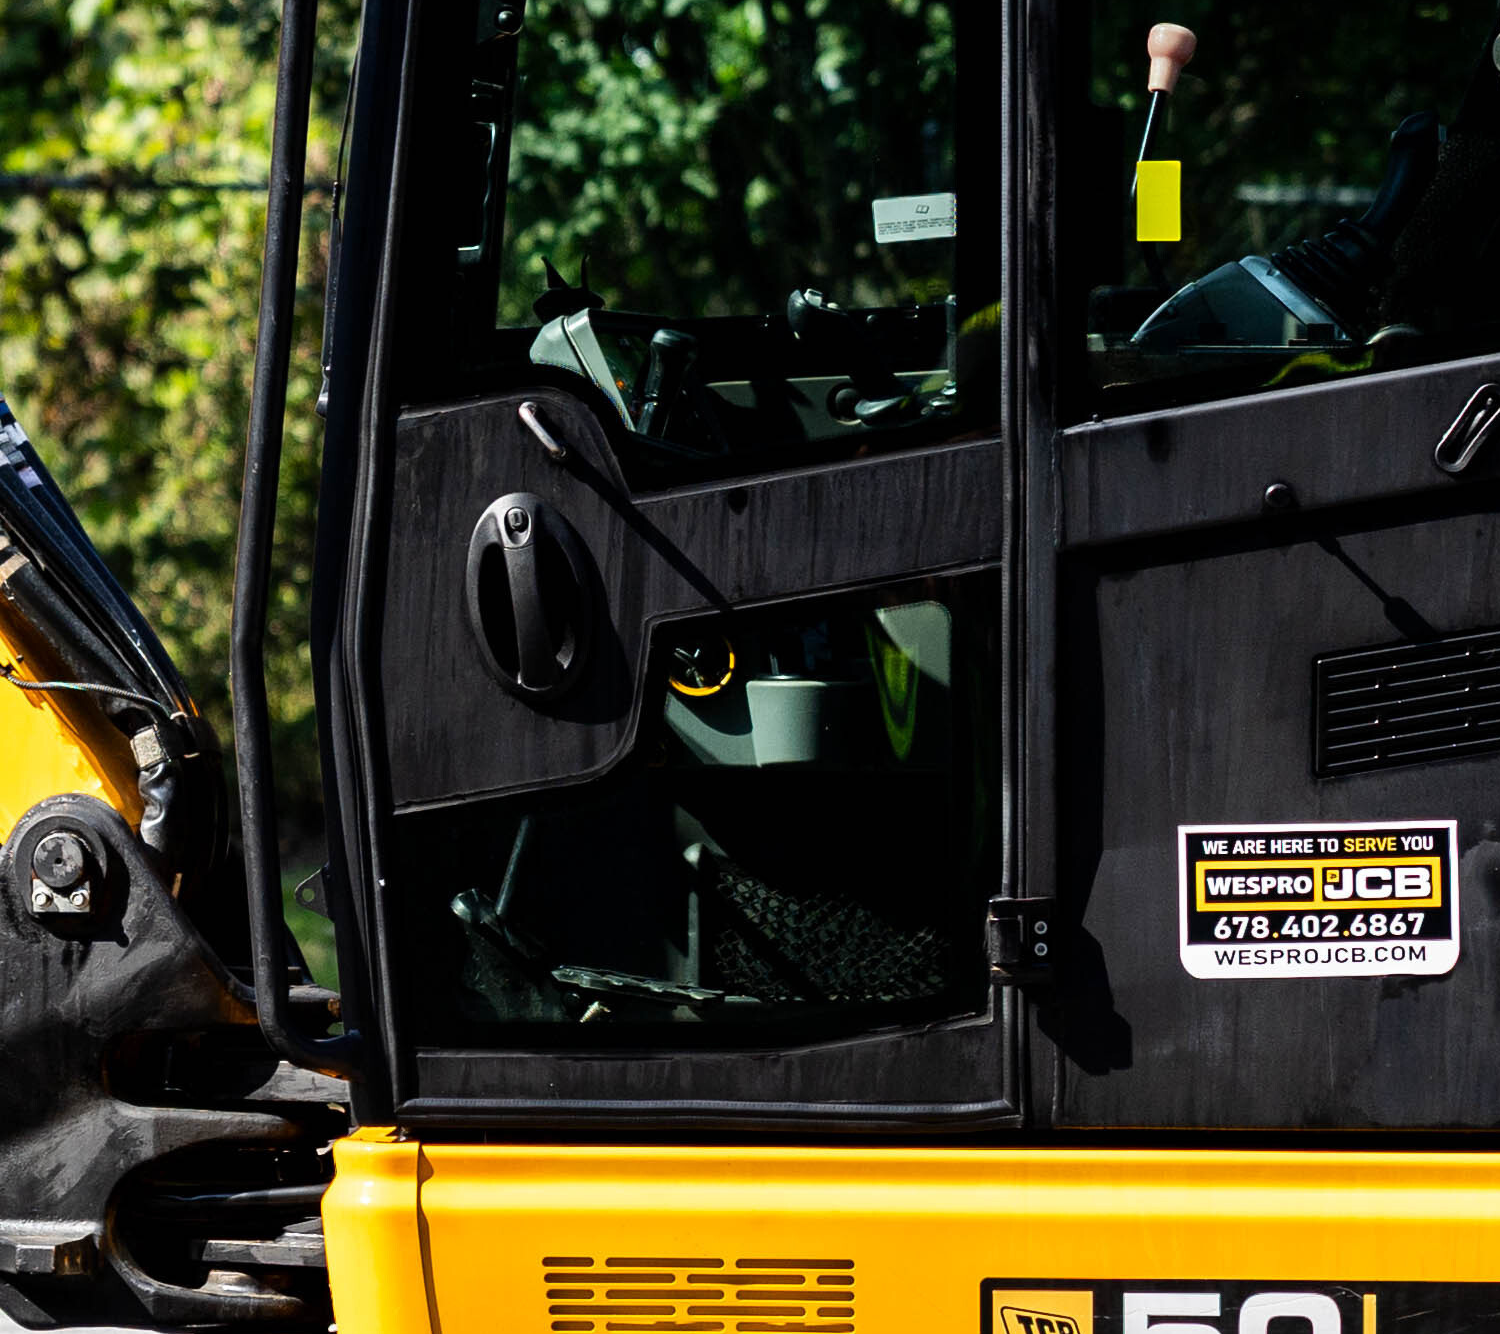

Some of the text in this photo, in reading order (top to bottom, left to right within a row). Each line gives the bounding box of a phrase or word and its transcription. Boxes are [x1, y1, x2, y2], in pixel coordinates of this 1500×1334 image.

[1202, 835, 1434, 855] WE ARE HERE TO SERVE YOU
[1206, 875, 1313, 895] WESPRO
[1323, 867, 1432, 900] JCB
[1213, 912, 1425, 940] 678.402.6867
[1214, 945, 1427, 966] WESPROJCB.COM
